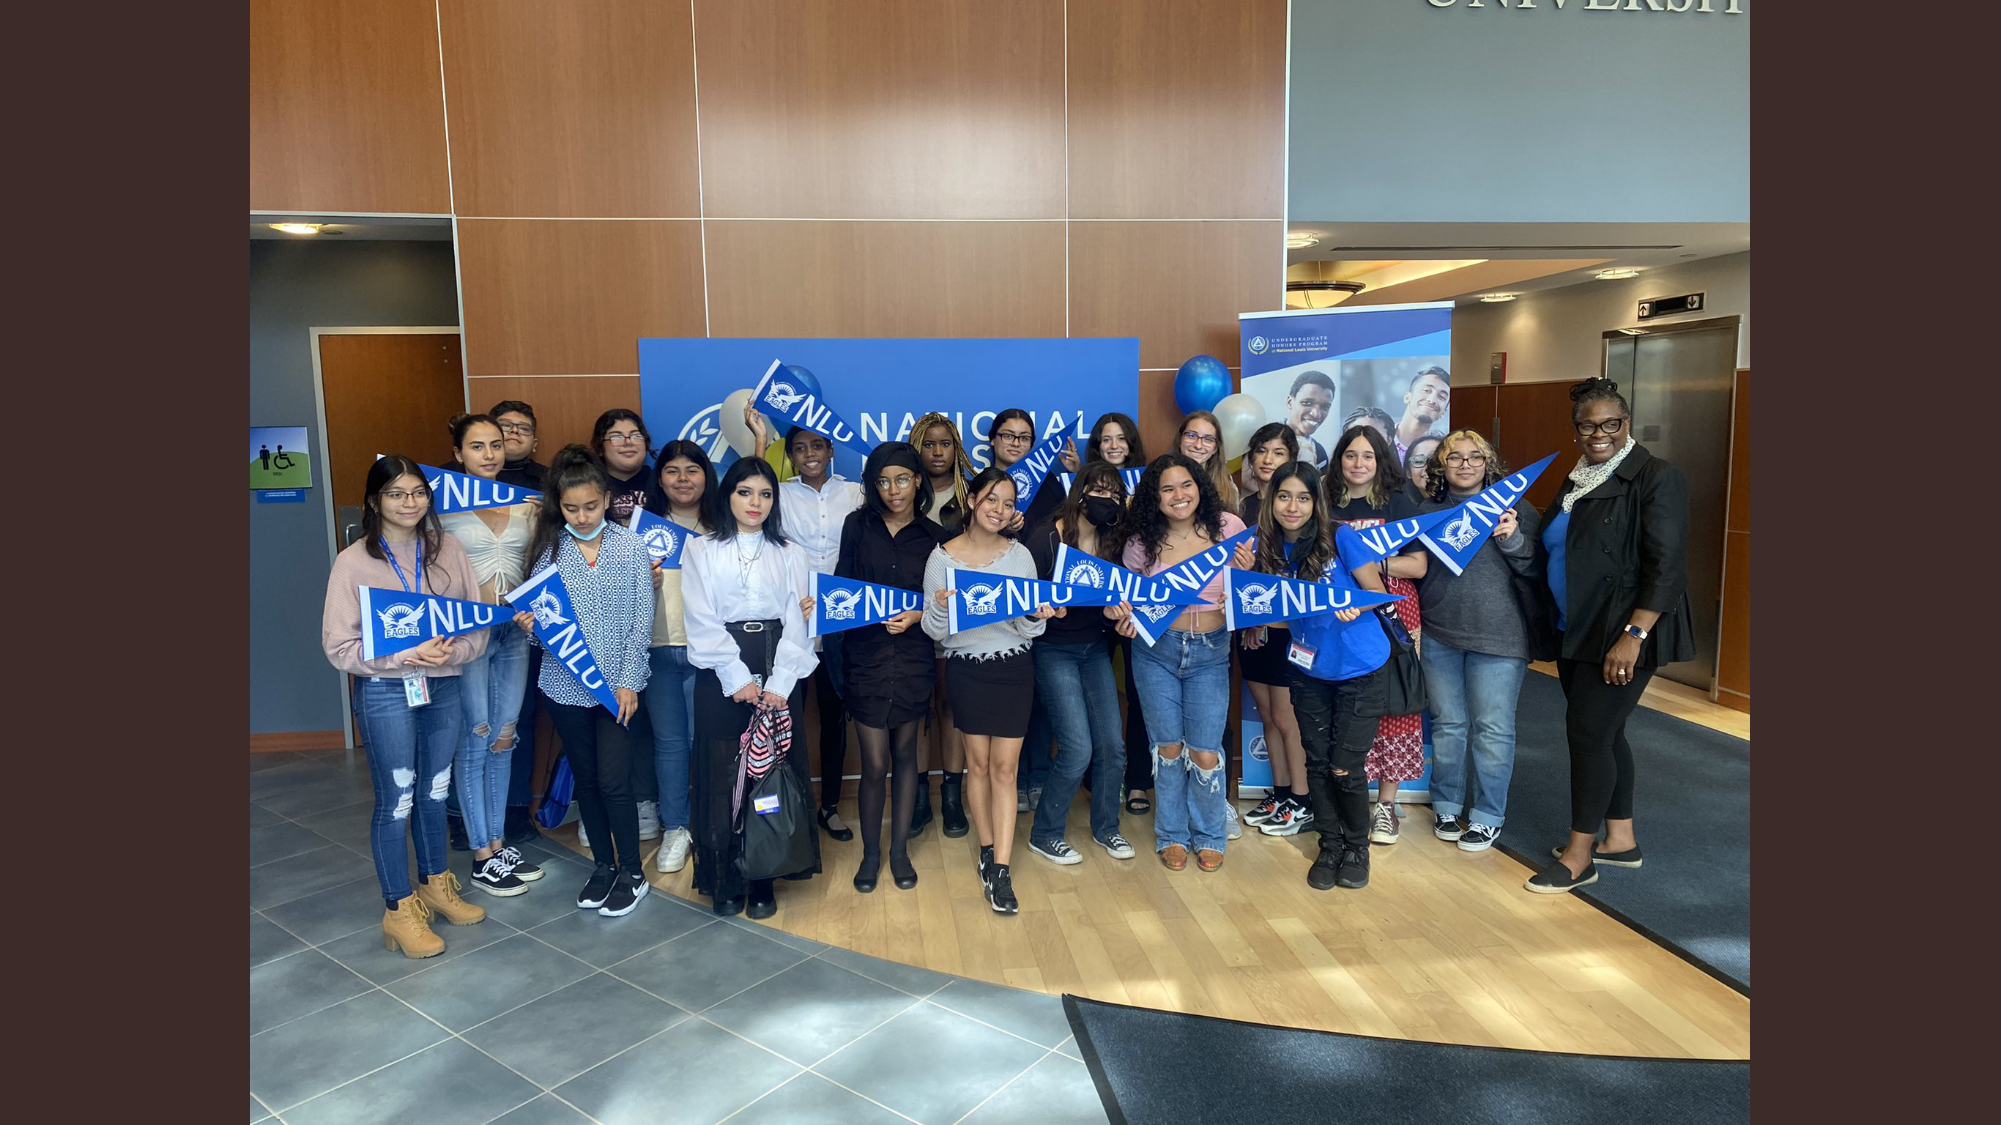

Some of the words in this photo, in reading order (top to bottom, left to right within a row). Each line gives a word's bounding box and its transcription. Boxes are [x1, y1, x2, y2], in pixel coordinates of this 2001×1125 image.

[764, 394, 789, 413] EAGLES
[792, 394, 854, 442] NLU
[860, 410, 1092, 442] NAIOAL
[1024, 434, 1064, 484] NLU
[443, 473, 515, 511] NLU
[1465, 473, 1528, 528] NLU
[1456, 528, 1480, 552] EAGLES
[1106, 566, 1171, 603] NLU
[1164, 545, 1228, 592] NLU
[529, 600, 550, 629] EAGLES
[827, 610, 855, 619] EAGLES
[865, 585, 918, 621] NLU
[967, 605, 996, 615] EAGLES
[1005, 578, 1073, 616] NLU
[1242, 605, 1272, 614] EAGLES
[1280, 579, 1351, 617] NLU
[385, 627, 420, 638] EAGLES
[427, 598, 494, 638] NLU
[547, 622, 604, 690] NLU
